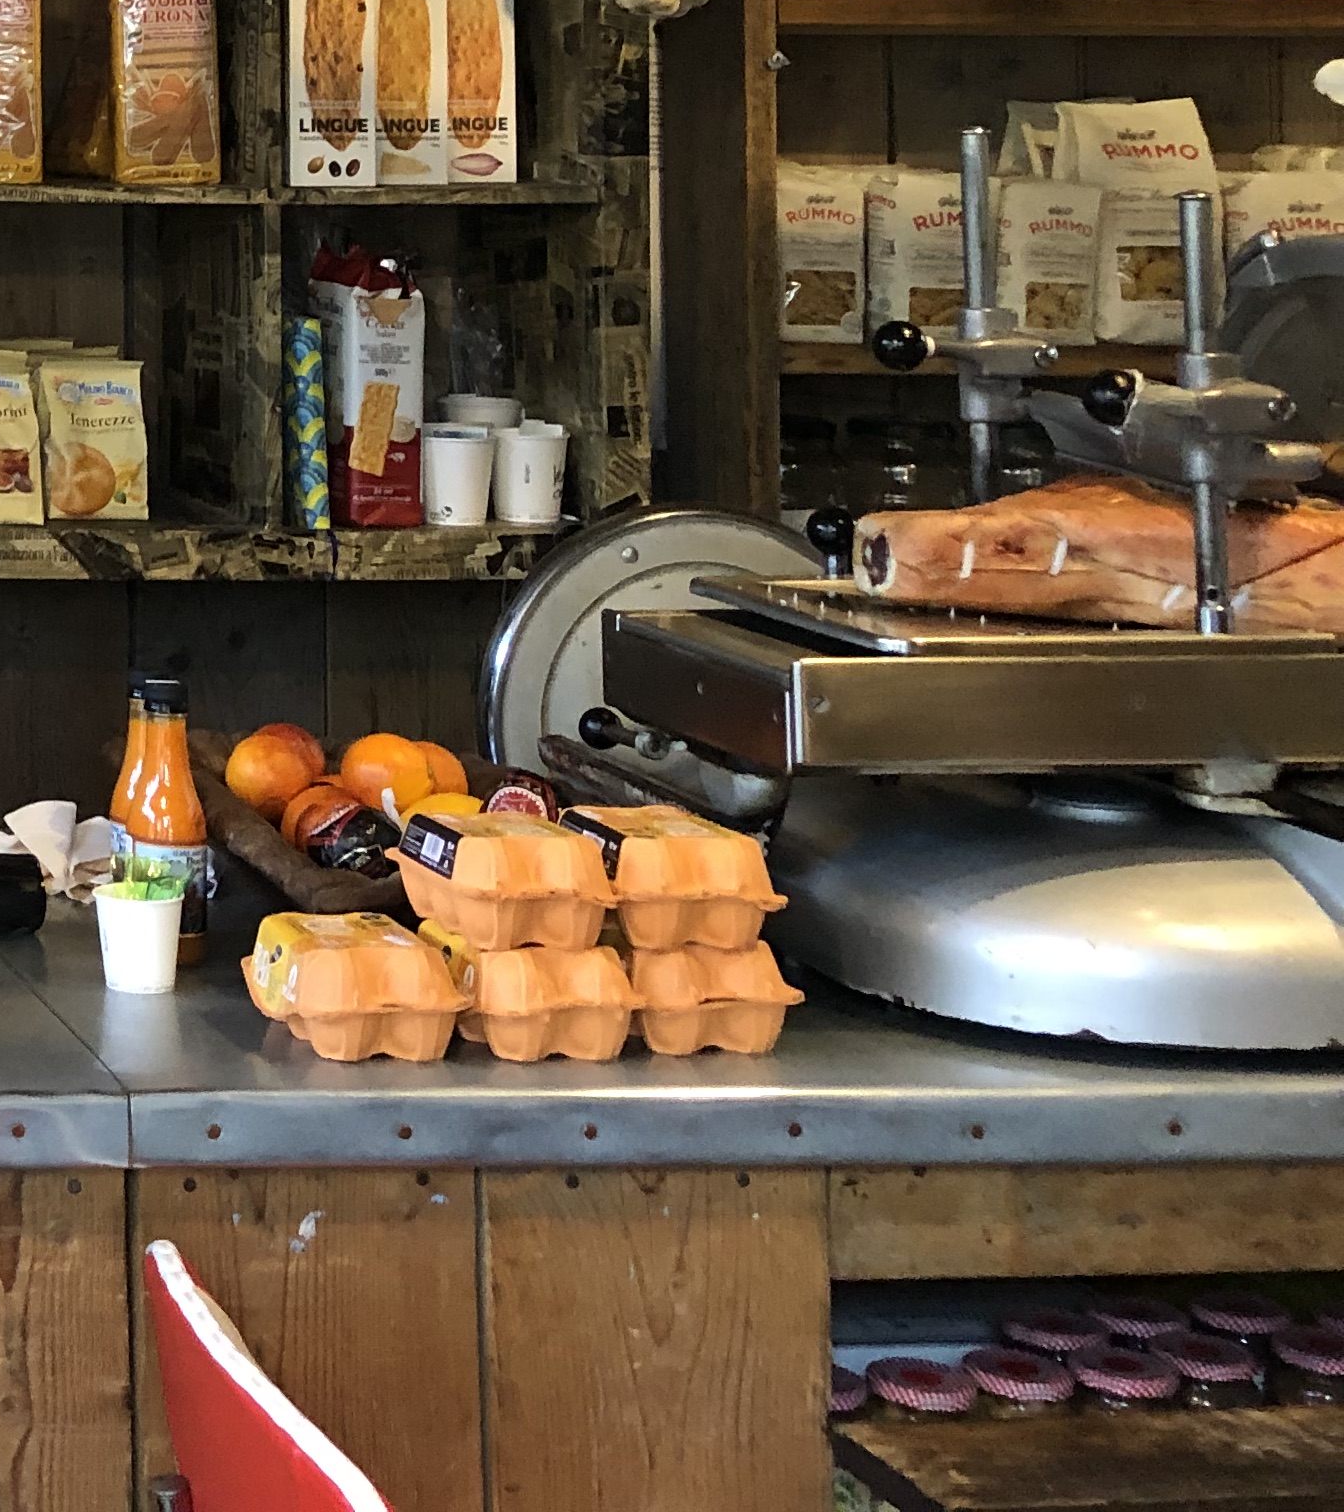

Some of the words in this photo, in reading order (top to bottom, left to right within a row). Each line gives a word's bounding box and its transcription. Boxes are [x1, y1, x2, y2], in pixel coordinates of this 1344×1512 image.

[299, 118, 369, 133] LINGUE
[375, 119, 440, 133] LINGUE
[447, 117, 508, 131] INGUE
[1101, 142, 1199, 160] RUMMO
[785, 208, 856, 225] RUMMO
[1028, 218, 1093, 237] RUMMO
[70, 412, 136, 428] Tenerezze
